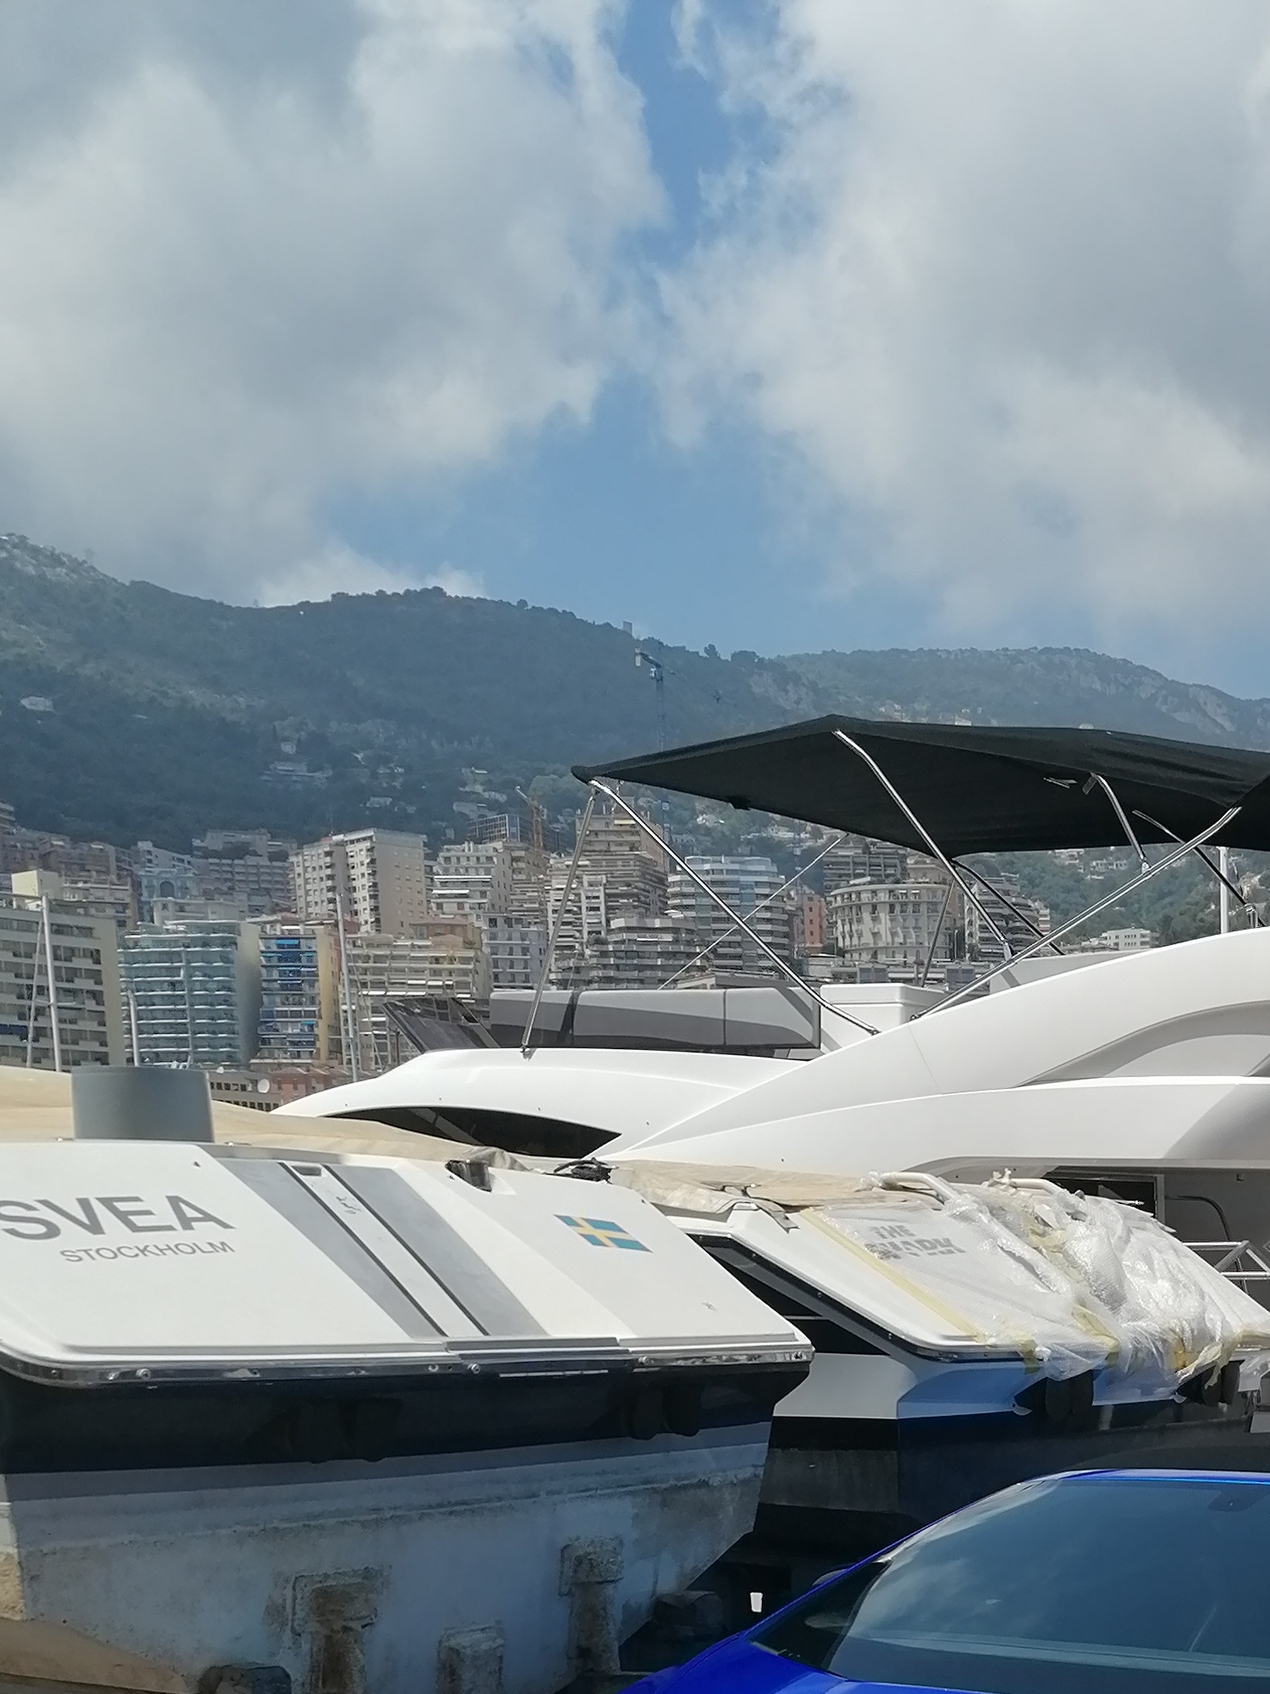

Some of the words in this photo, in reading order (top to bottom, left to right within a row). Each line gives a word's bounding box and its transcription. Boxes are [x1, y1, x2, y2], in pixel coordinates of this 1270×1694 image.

[0, 1195, 237, 1240] SVEA
[868, 1225, 916, 1239] THE
[59, 1241, 236, 1263] STOCKHOLM
